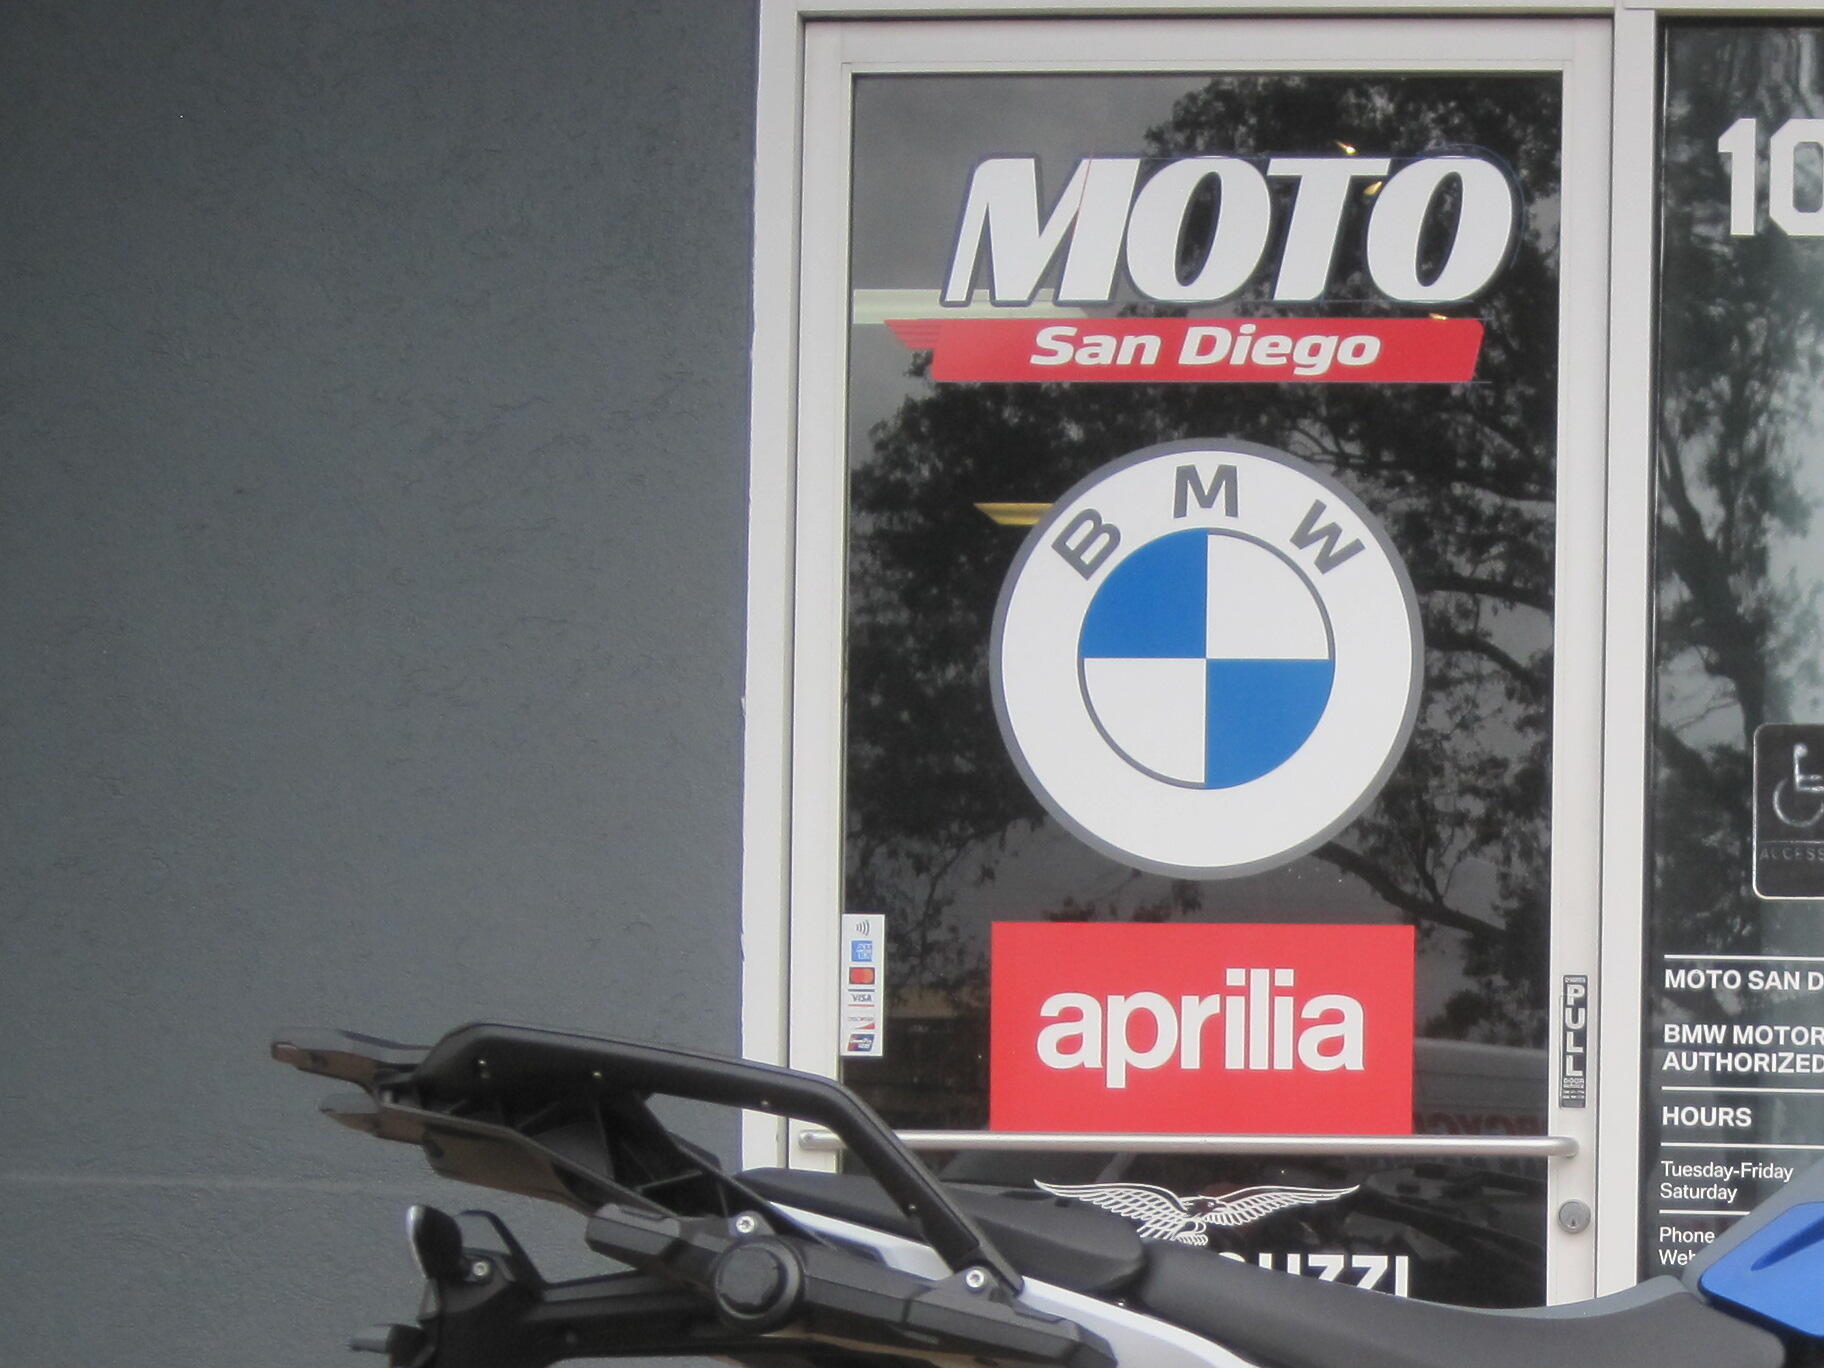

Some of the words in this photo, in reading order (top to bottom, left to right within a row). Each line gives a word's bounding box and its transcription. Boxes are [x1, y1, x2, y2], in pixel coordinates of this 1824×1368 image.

[942, 155, 1516, 304] MOTO
[1030, 325, 1160, 367] San
[1178, 323, 1381, 375] Diego
[1050, 464, 1366, 579] BMW
[1664, 969, 1742, 990] MOTO
[1748, 970, 1800, 991] SAN
[1035, 968, 1365, 1088] aprilia
[1565, 984, 1586, 1077] PULL
[1664, 1024, 1727, 1044] BMW
[1662, 1106, 1752, 1127] HOURS
[1661, 1160, 1794, 1183] Tuesday-Friday
[1660, 1182, 1738, 1204] Saturday
[1660, 1226, 1715, 1244] Phone
